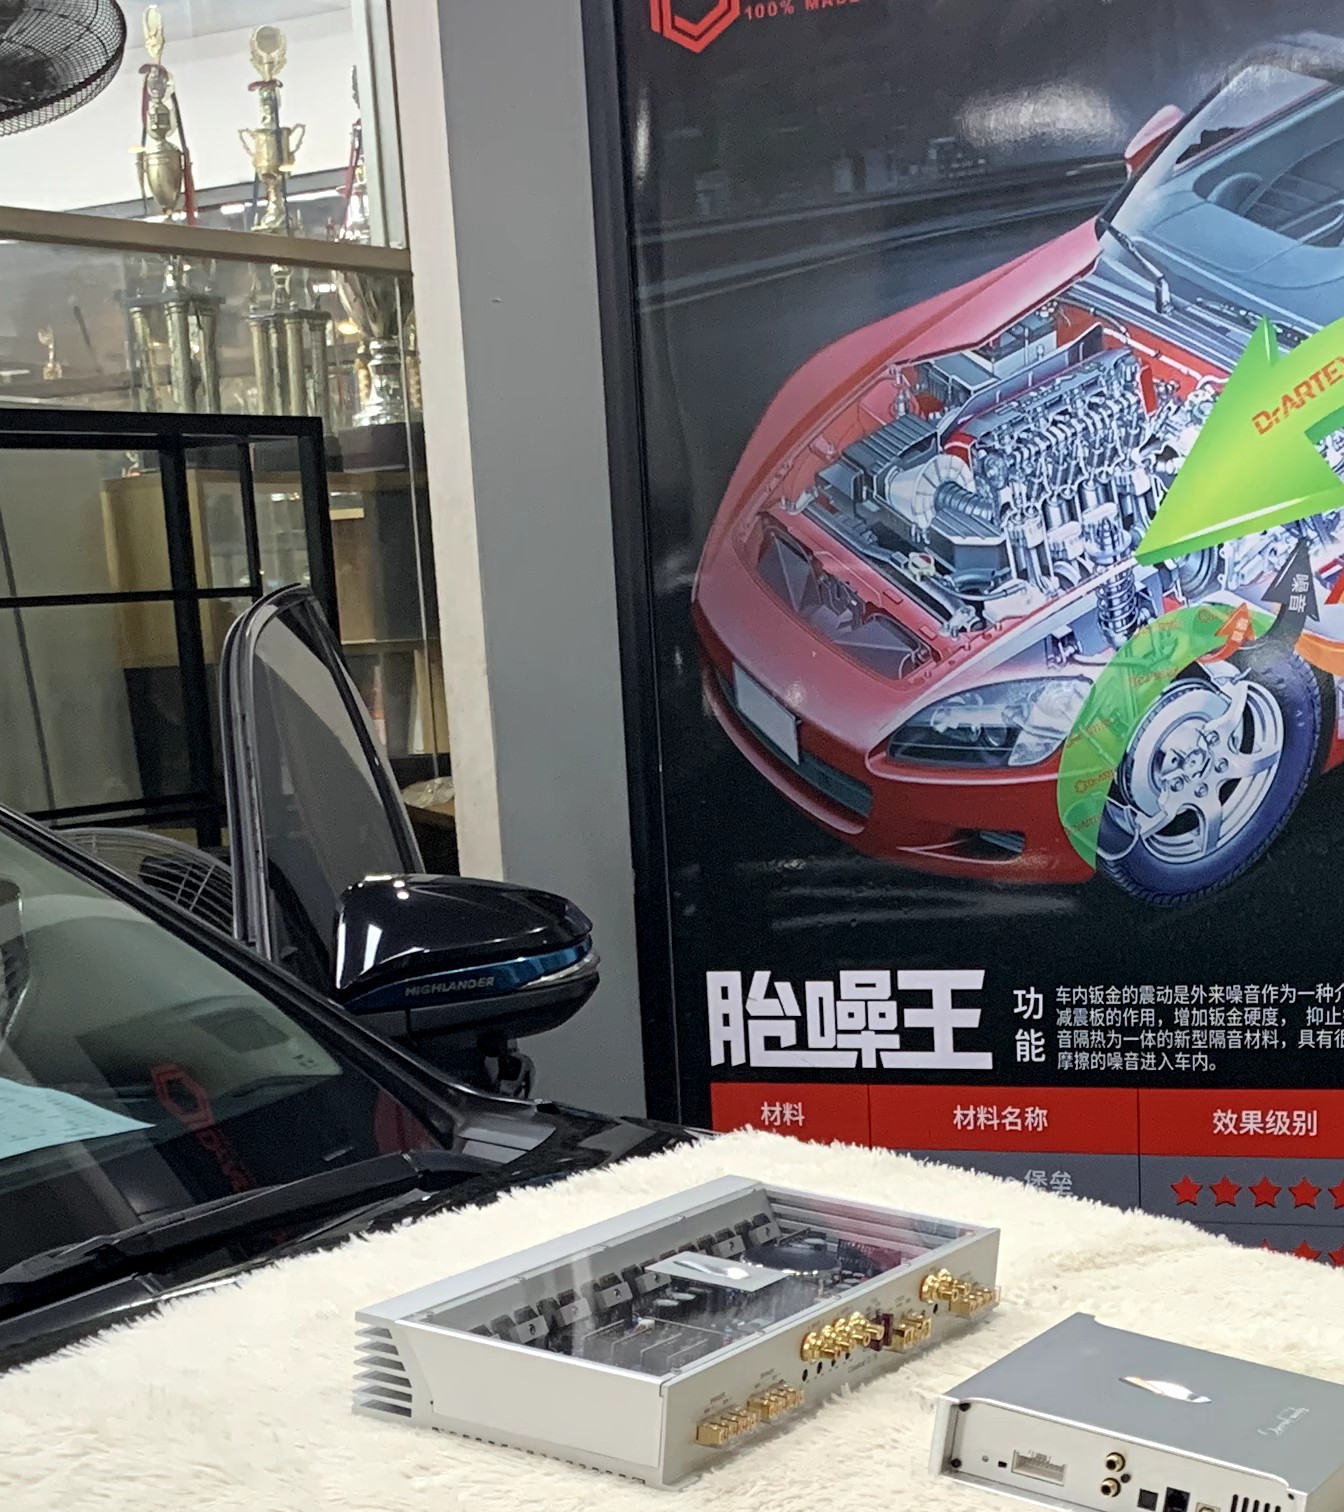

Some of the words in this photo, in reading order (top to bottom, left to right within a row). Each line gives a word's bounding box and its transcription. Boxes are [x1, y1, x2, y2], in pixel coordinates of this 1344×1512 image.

[744, 0, 795, 20] 100%
[404, 976, 495, 997] HIGHLANDER
[706, 969, 994, 1070] 胎噪王
[1013, 986, 1047, 1064] 功能
[1057, 1051, 1217, 1072] 摩擦的噪音进入车内。
[761, 1101, 805, 1127] 材料
[953, 1105, 1048, 1132] 材料名称
[1212, 1109, 1318, 1137] 效果级别
